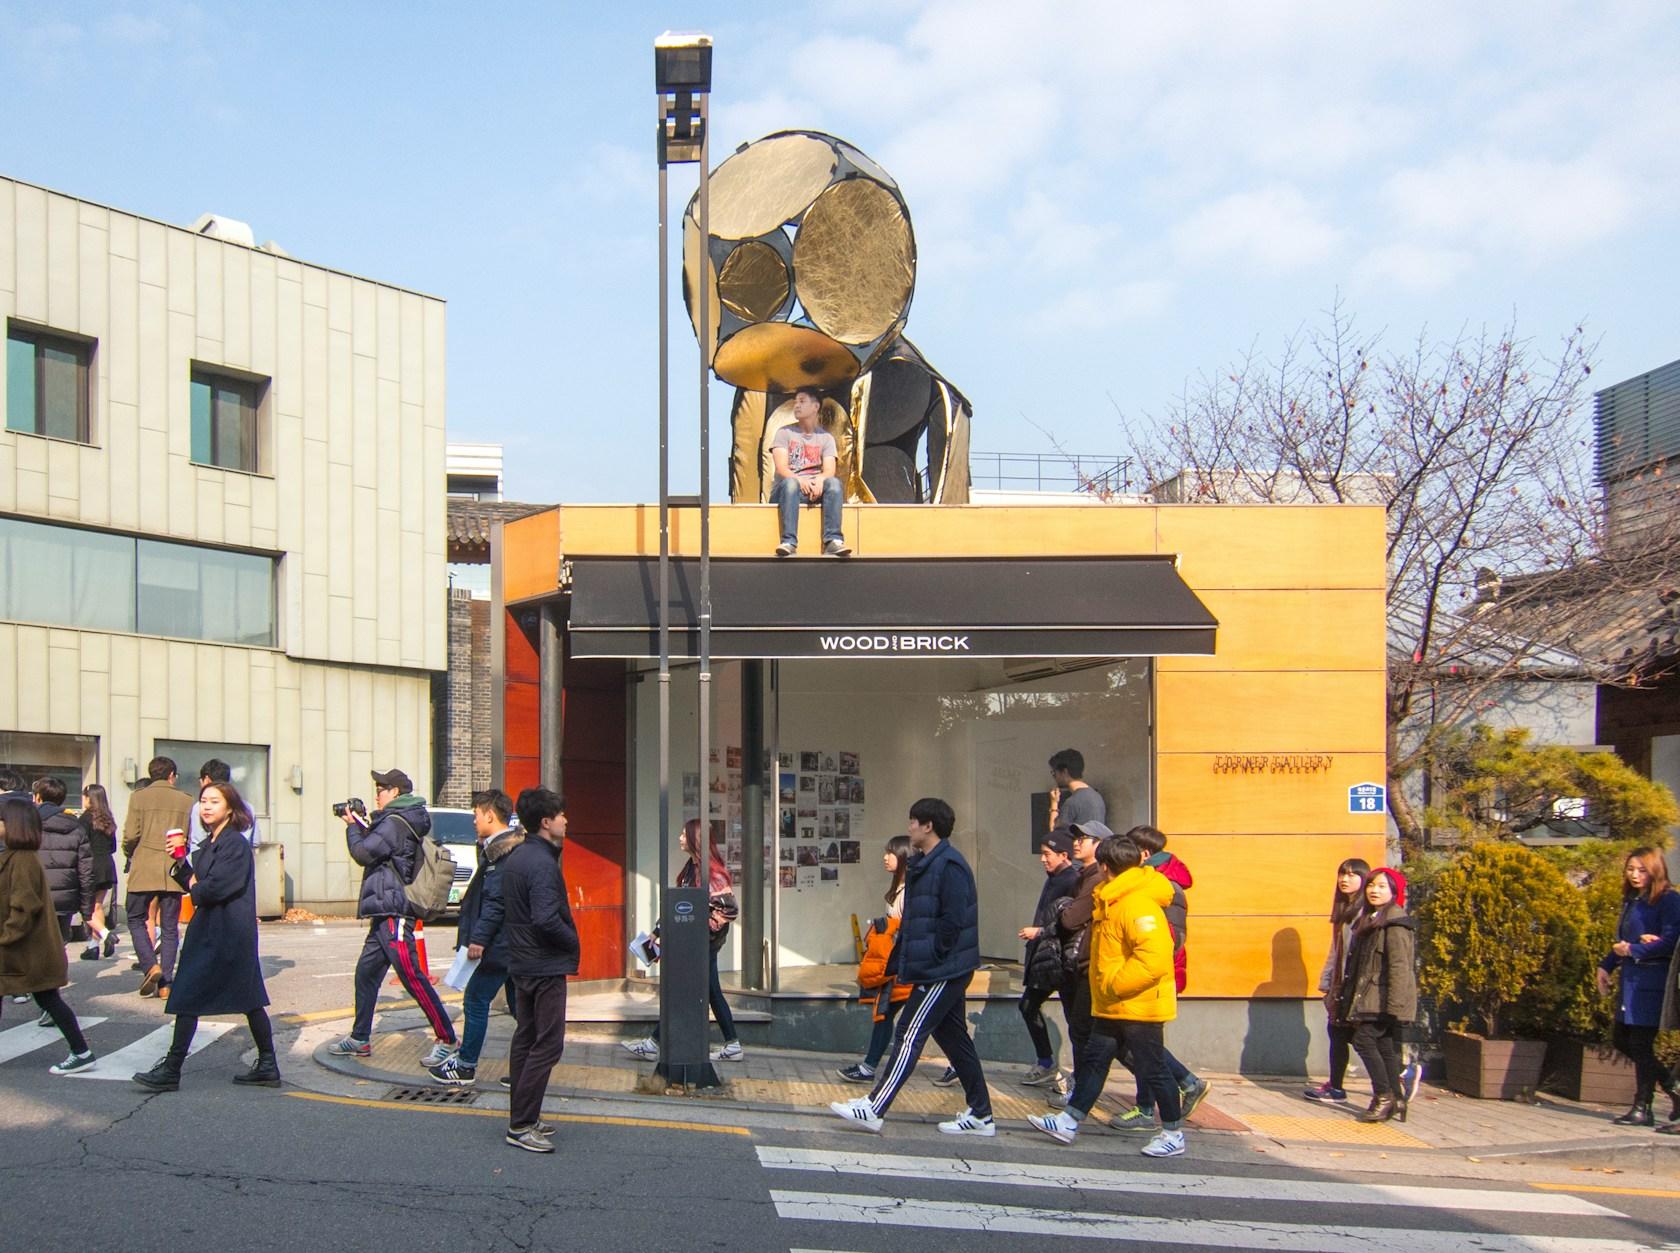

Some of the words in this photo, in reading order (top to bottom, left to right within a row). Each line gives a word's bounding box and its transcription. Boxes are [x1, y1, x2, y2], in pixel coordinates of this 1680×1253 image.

[820, 636, 890, 650] WOOD
[900, 636, 969, 650] BRICK
[1215, 756, 1269, 769] CORNER
[1274, 755, 1334, 769] GALLERY
[1359, 797, 1376, 810] 18
